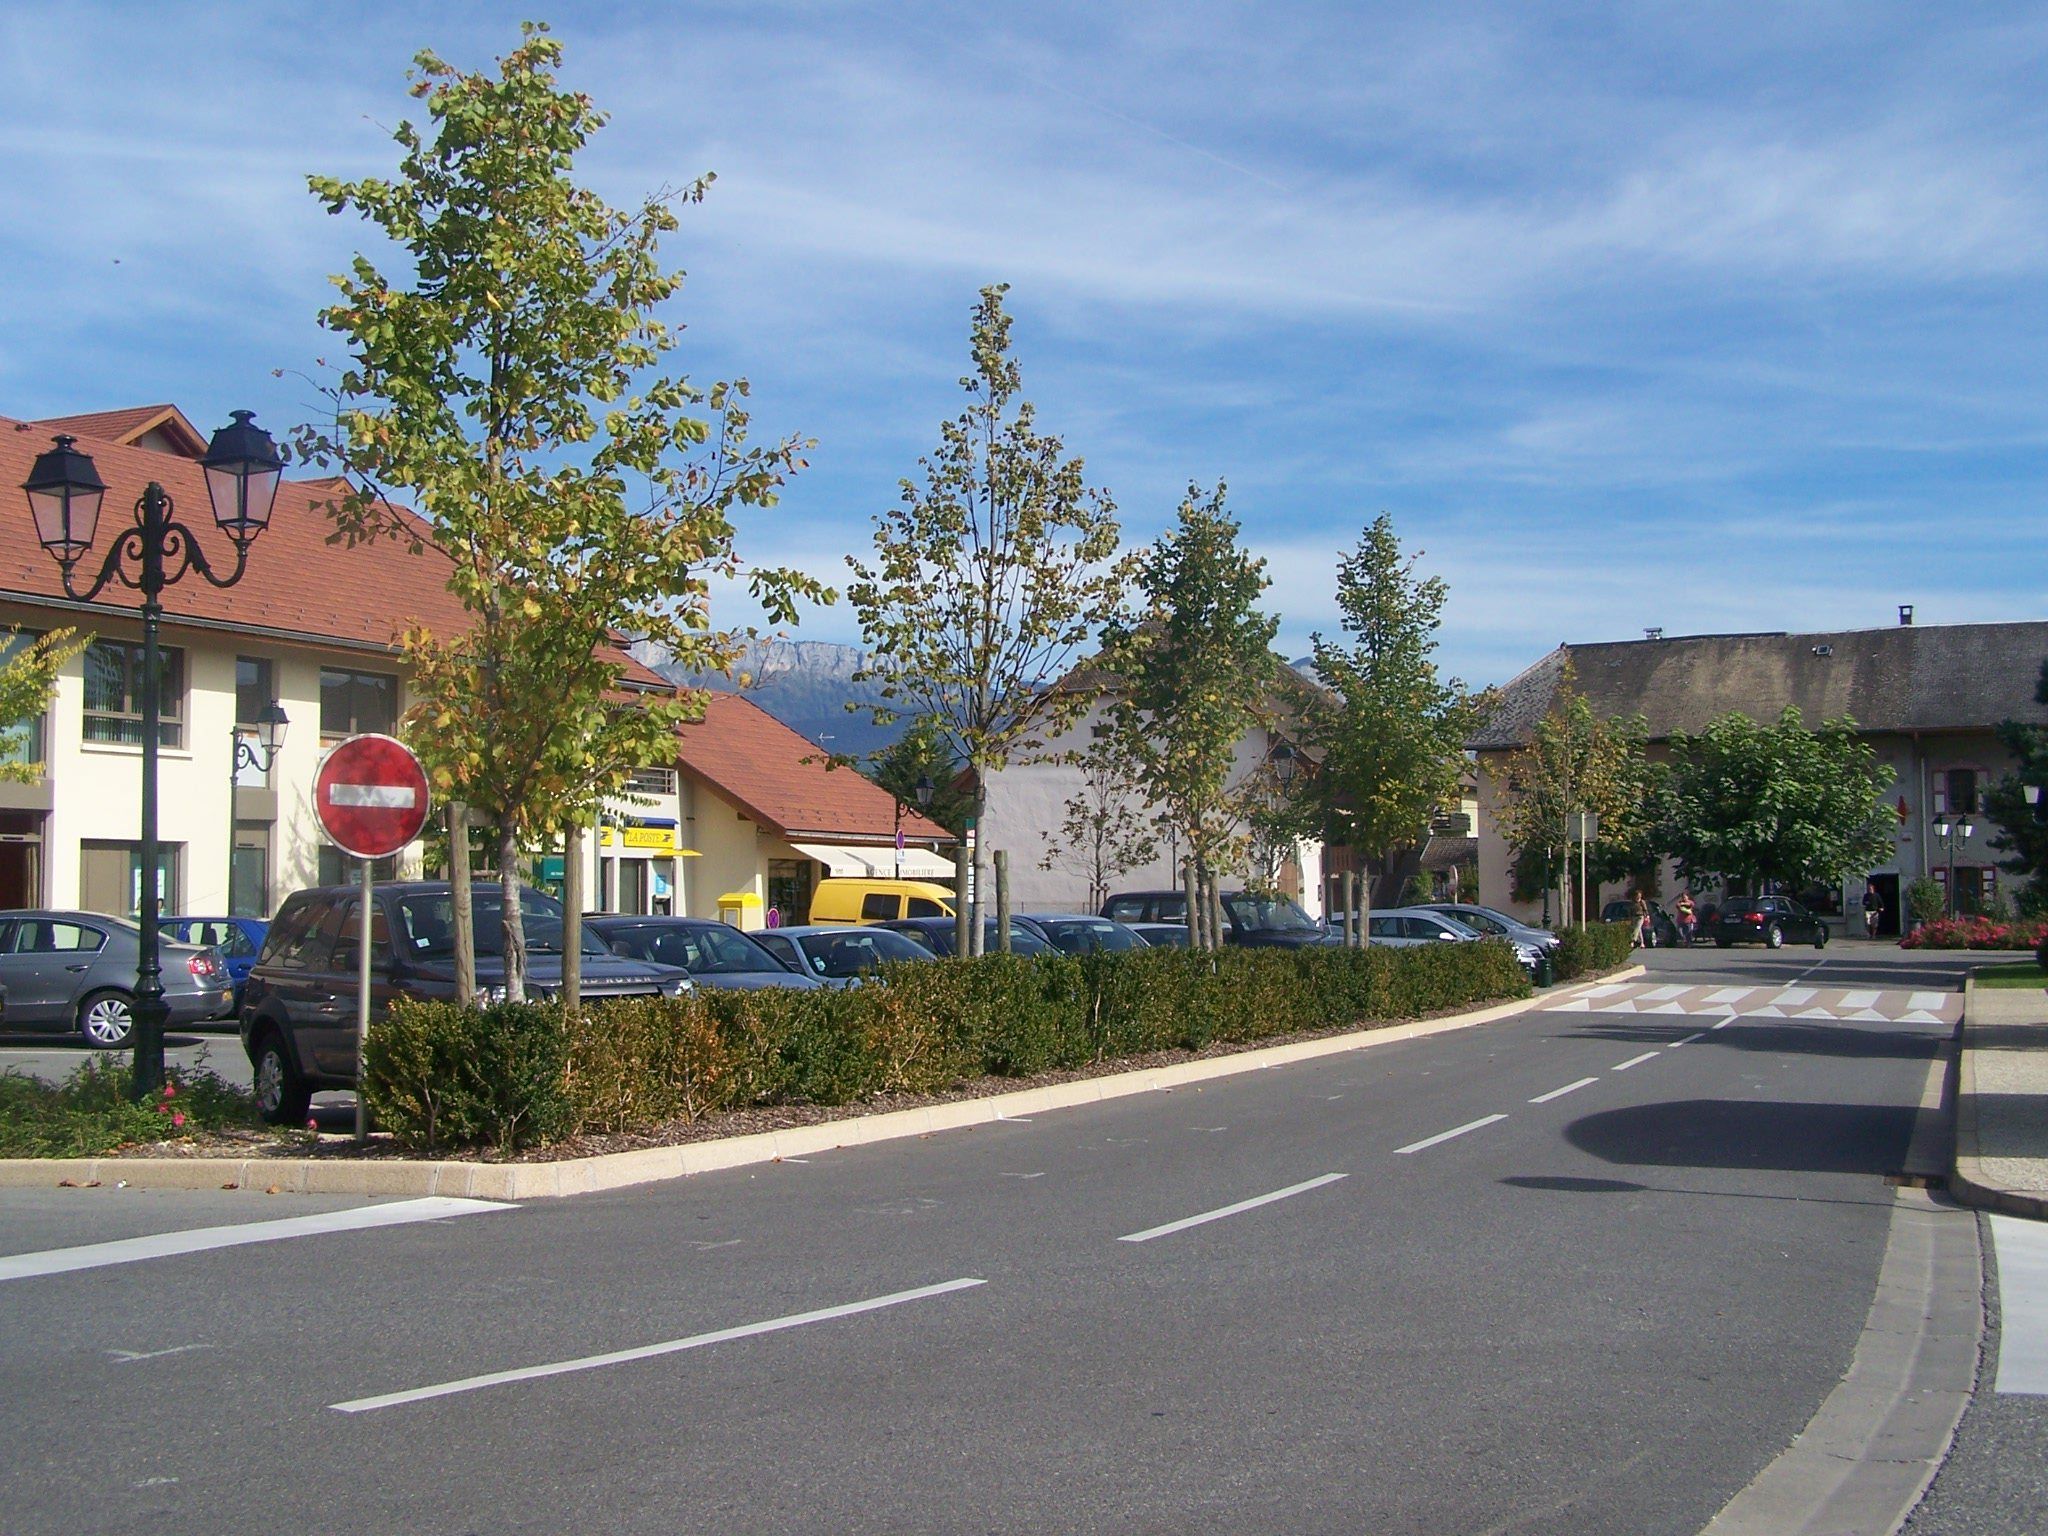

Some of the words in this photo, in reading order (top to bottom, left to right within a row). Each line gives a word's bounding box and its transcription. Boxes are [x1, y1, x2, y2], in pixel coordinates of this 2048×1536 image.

[628, 833, 639, 842] LA
[639, 833, 661, 843] POSTE
[866, 868, 891, 877] AGENCE
